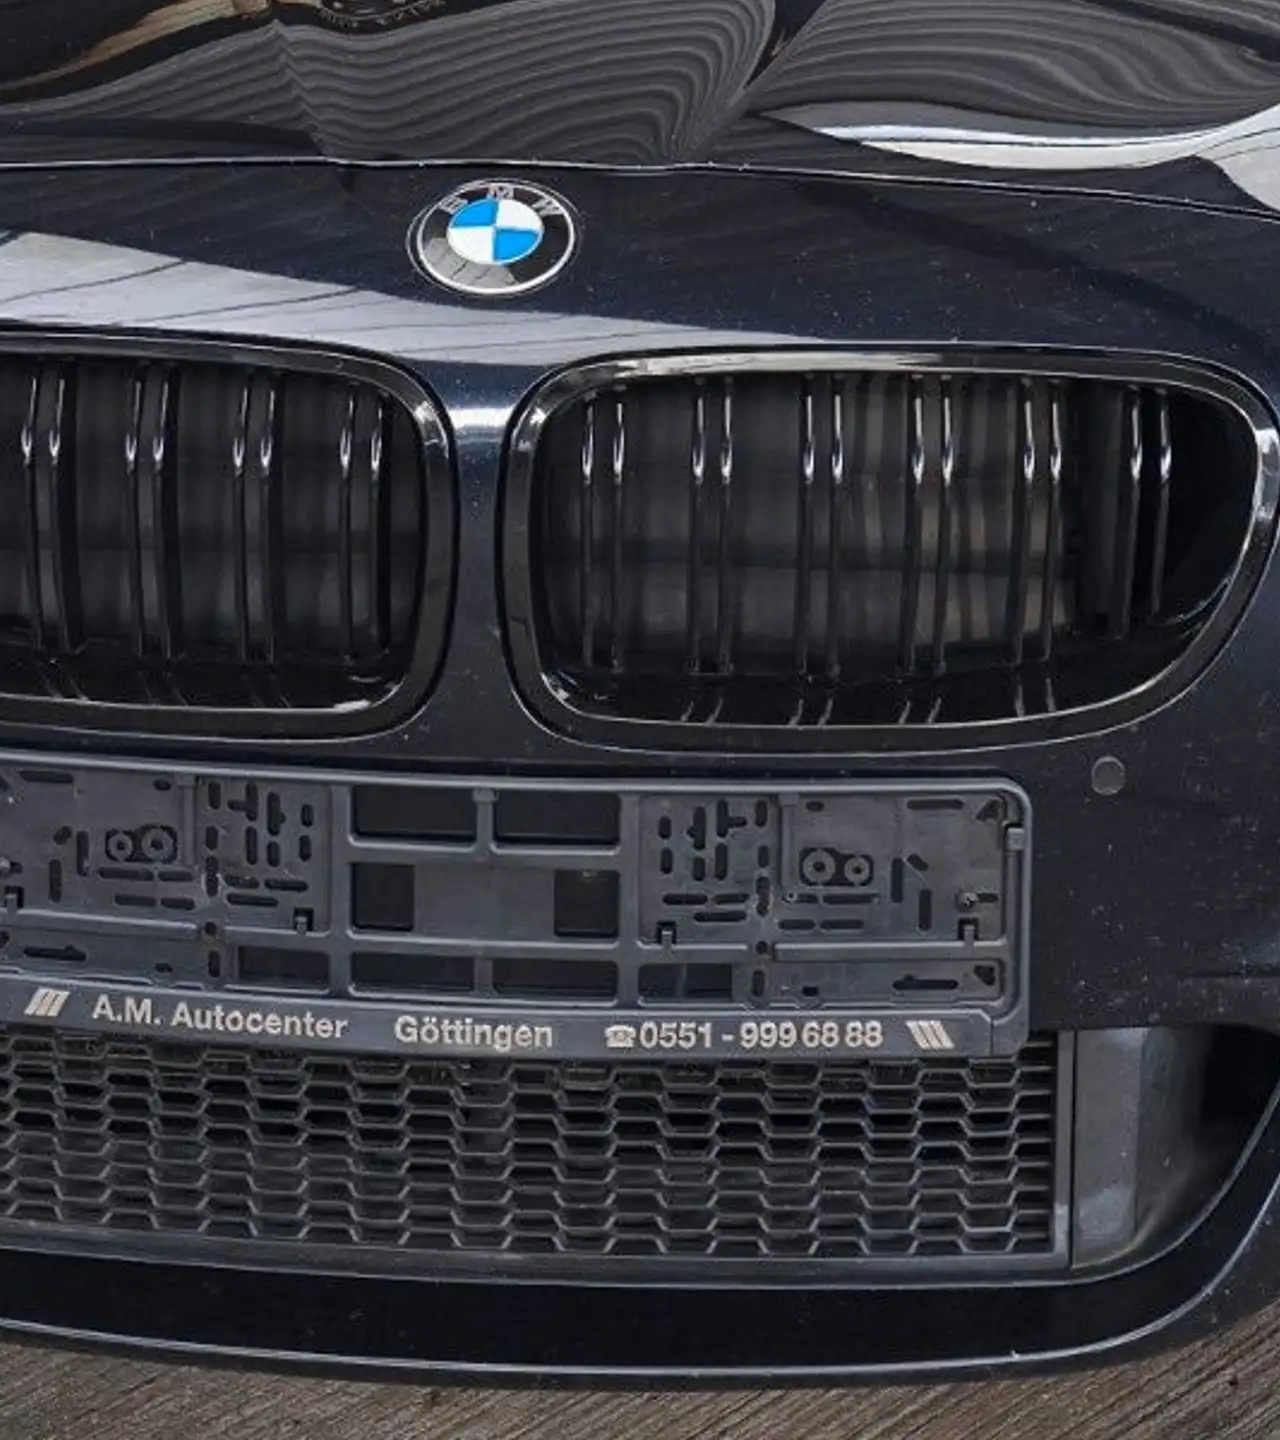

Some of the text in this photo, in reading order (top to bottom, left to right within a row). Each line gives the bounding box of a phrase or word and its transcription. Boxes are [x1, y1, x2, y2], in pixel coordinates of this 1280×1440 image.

[438, 183, 563, 215] BMW
[92, 994, 161, 1025] A.M.
[171, 1001, 348, 1038] Autocenter
[394, 1015, 554, 1052] Göttingen
[639, 1020, 712, 1048] 0551
